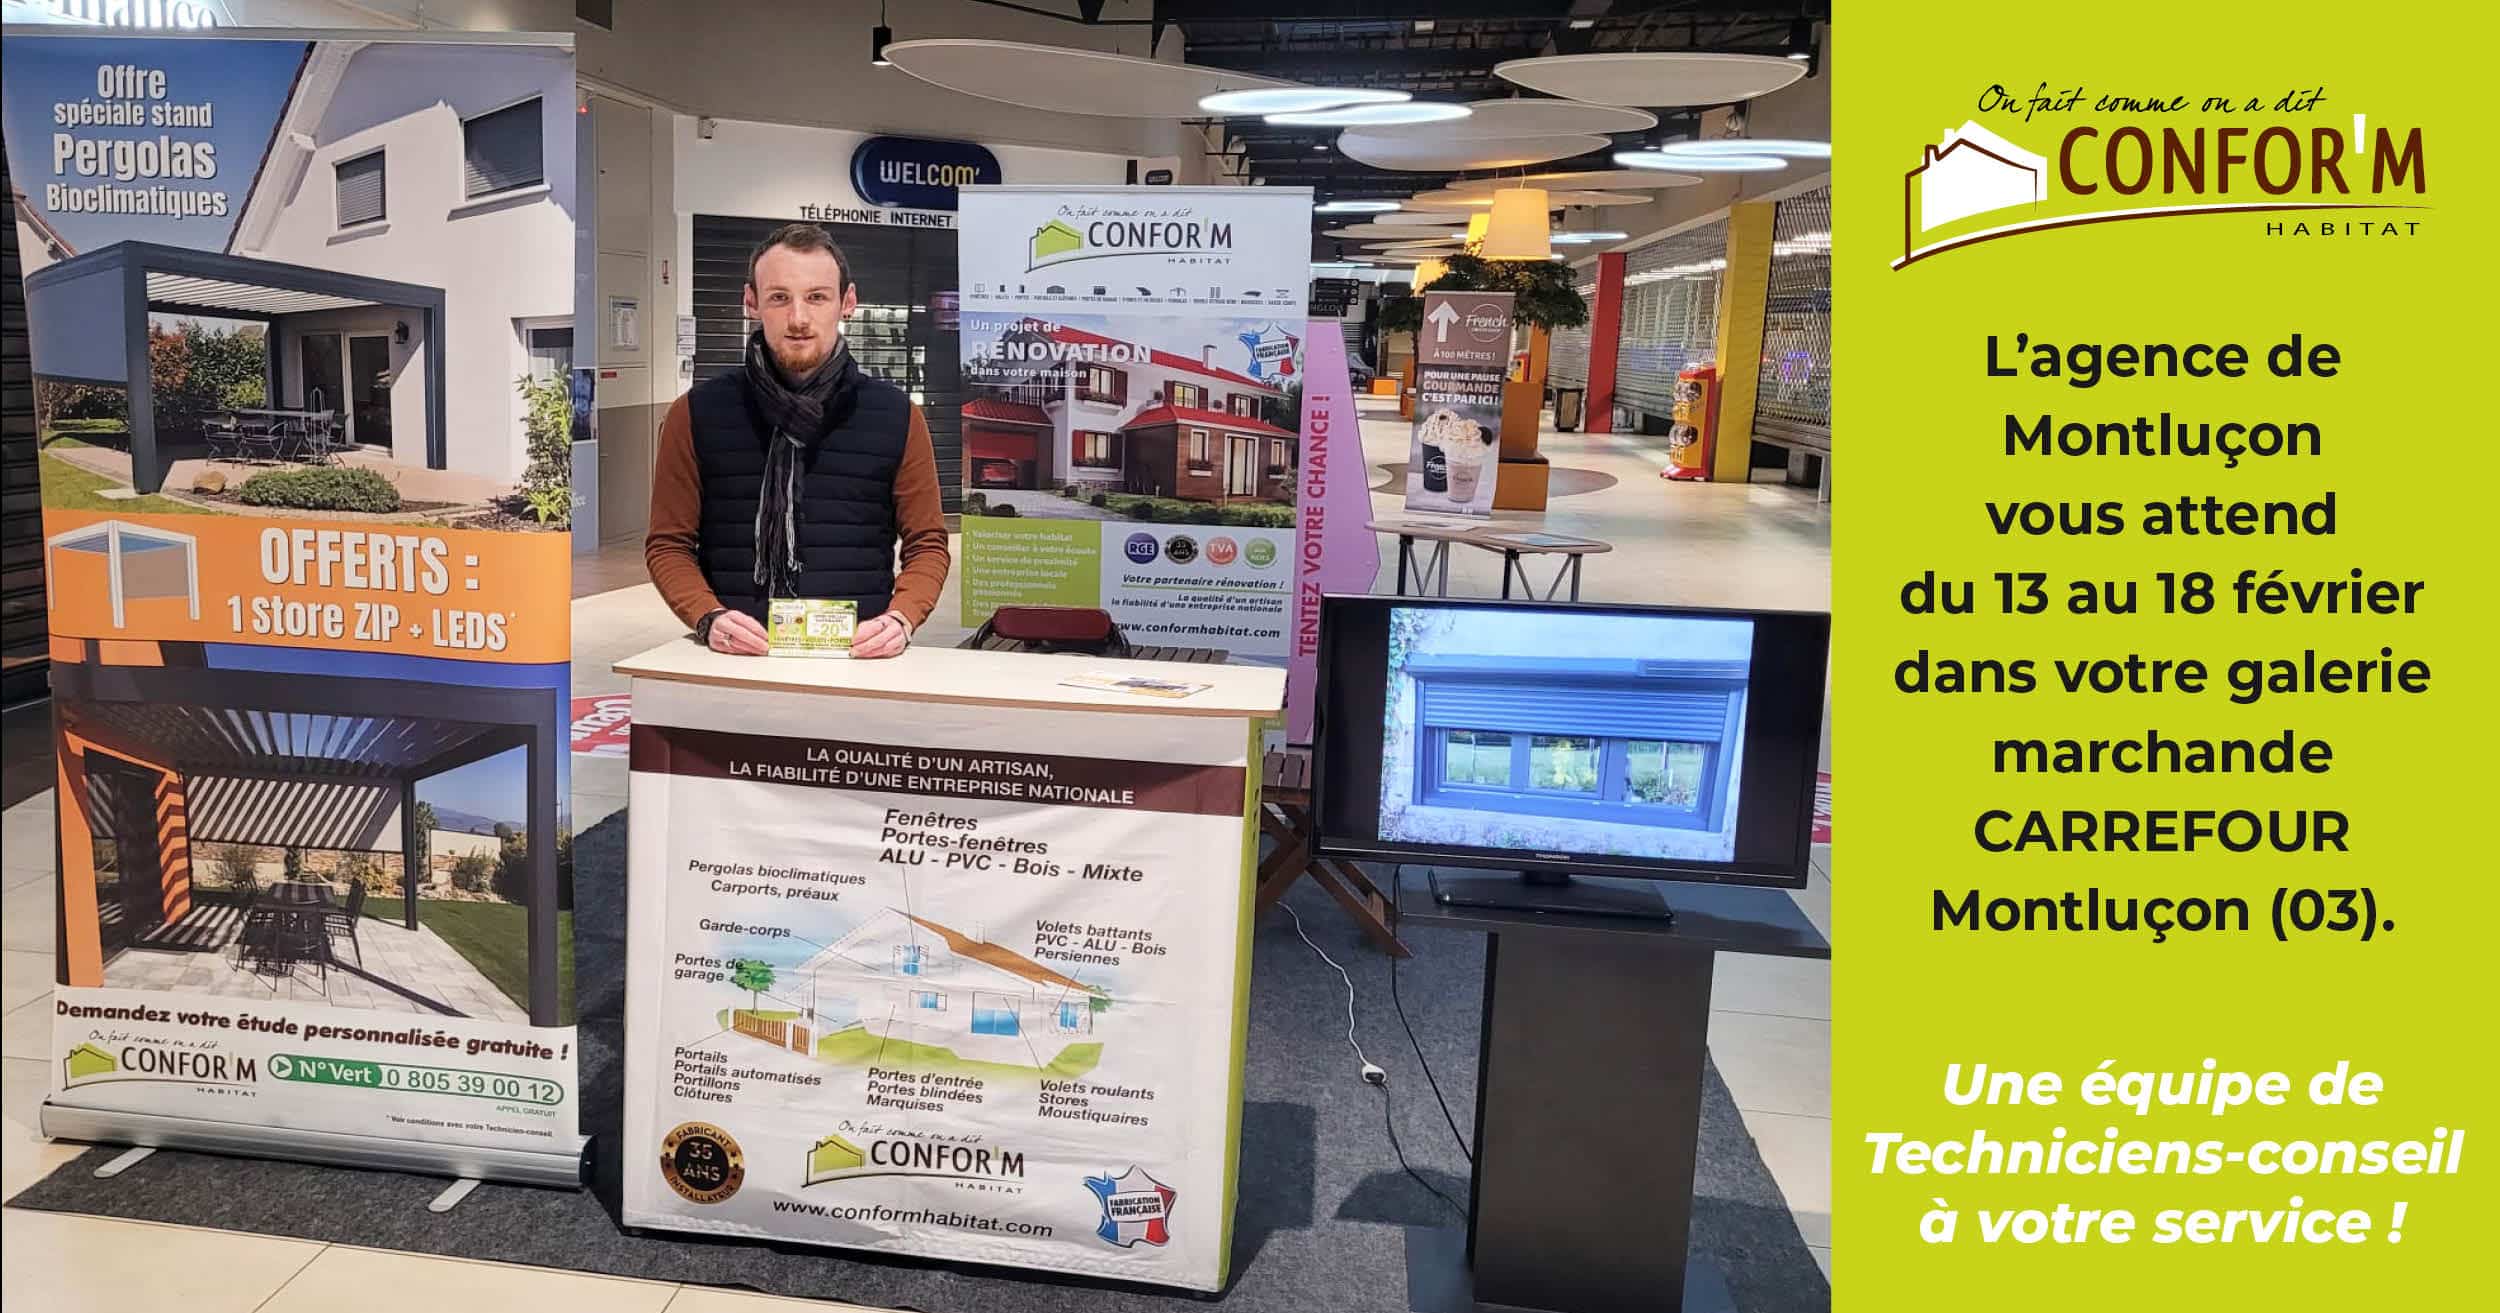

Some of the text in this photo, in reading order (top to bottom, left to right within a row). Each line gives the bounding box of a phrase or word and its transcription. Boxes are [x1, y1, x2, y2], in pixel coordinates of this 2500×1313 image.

[97, 64, 166, 99] Offre
[54, 99, 213, 128] spéciale stand
[53, 133, 217, 181] Pergolas
[47, 184, 228, 218] Bioclimatiques
[800, 203, 952, 227] TÉLÉPHONIE INTERNET
[1088, 216, 1232, 249] CONFOR'M
[1167, 257, 1232, 265] HABITAT
[970, 319, 1061, 335] Un projet de
[971, 336, 1150, 363] RÉNOVATION
[1441, 350, 1455, 359] 100
[970, 364, 1087, 379] dans votre maison
[1424, 371, 1500, 382] POUR UNE PAUSE
[1423, 381, 1499, 393] GOURMANDE
[1454, 395, 1477, 404] PAR
[1299, 410, 1329, 657] TENTEZ VOTRE CHANCE
[1129, 542, 1154, 554] RGE
[1209, 543, 1233, 553] TVA
[260, 527, 449, 595] OFFERTS
[1123, 575, 1276, 589] Votre partenaire rénovation
[1112, 597, 1282, 613] la fiabilité d'une entreprise nationale
[1191, 594, 1224, 604] qualité
[1226, 595, 1247, 604] d'un
[1250, 597, 1283, 605] artisan
[227, 595, 243, 632] 1
[252, 595, 344, 639] Store
[354, 602, 399, 641] ZIP
[1119, 622, 1280, 639] ww.conformhabitat.com
[806, 747, 1054, 780] LA QUALITÉ D'UN ARTISAN,
[729, 762, 1134, 805] LA FIABILITÉ D'UNE ENTREPRISE NATIONALE
[884, 809, 979, 831] Fenêtres
[880, 828, 1048, 855] Portes-fenêtres
[688, 859, 867, 885] Pergolas bioclimatiques
[879, 848, 1143, 883] ALU PVC Bois Mixte
[711, 879, 840, 902] Carports, préaux
[699, 918, 791, 939] Garde-corps
[1036, 919, 1152, 941] Volets battants
[1035, 933, 1167, 956] PVC ALU Bois
[674, 953, 744, 971] Portes de
[1034, 947, 1120, 966] Persiennes
[674, 967, 724, 984] garage
[57, 1000, 553, 1060] Demandez votre étude personnalisée gratuite
[121, 1046, 257, 1082] CONFOR'M
[674, 1046, 728, 1063] Portails
[299, 1060, 371, 1084] N° Vert
[674, 1059, 822, 1086] Portails automatisés
[674, 1073, 741, 1091] Portillons
[868, 1067, 983, 1089] Portes d'entrée
[197, 1087, 257, 1097] HABITAT
[387, 1069, 554, 1101] 0 805 39 00 12
[673, 1085, 733, 1103] Clôtures
[867, 1080, 983, 1104] Portes blindées
[1040, 1079, 1155, 1100] Volets roulants
[866, 1094, 944, 1112] Marquises
[1038, 1092, 1089, 1107] Stores
[496, 1104, 557, 1118] APPEL GRATUIT
[1038, 1105, 1149, 1126] Moustiquaires
[406, 1116, 444, 1128] conditions
[447, 1121, 463, 1129] avec
[465, 1123, 483, 1131] votre
[676, 1126, 731, 1147] FABRICANT
[688, 1141, 713, 1160] 35
[871, 1140, 1025, 1178] CONFOR'M
[684, 1163, 721, 1181] ANS
[670, 1176, 735, 1201] INSTALLATEUR
[955, 1182, 1023, 1194] HABITAT
[1110, 1197, 1161, 1206] FABRICATION
[1111, 1204, 1162, 1217] FRANÇAISE
[773, 1200, 1053, 1237] www.conformhabitat.com
